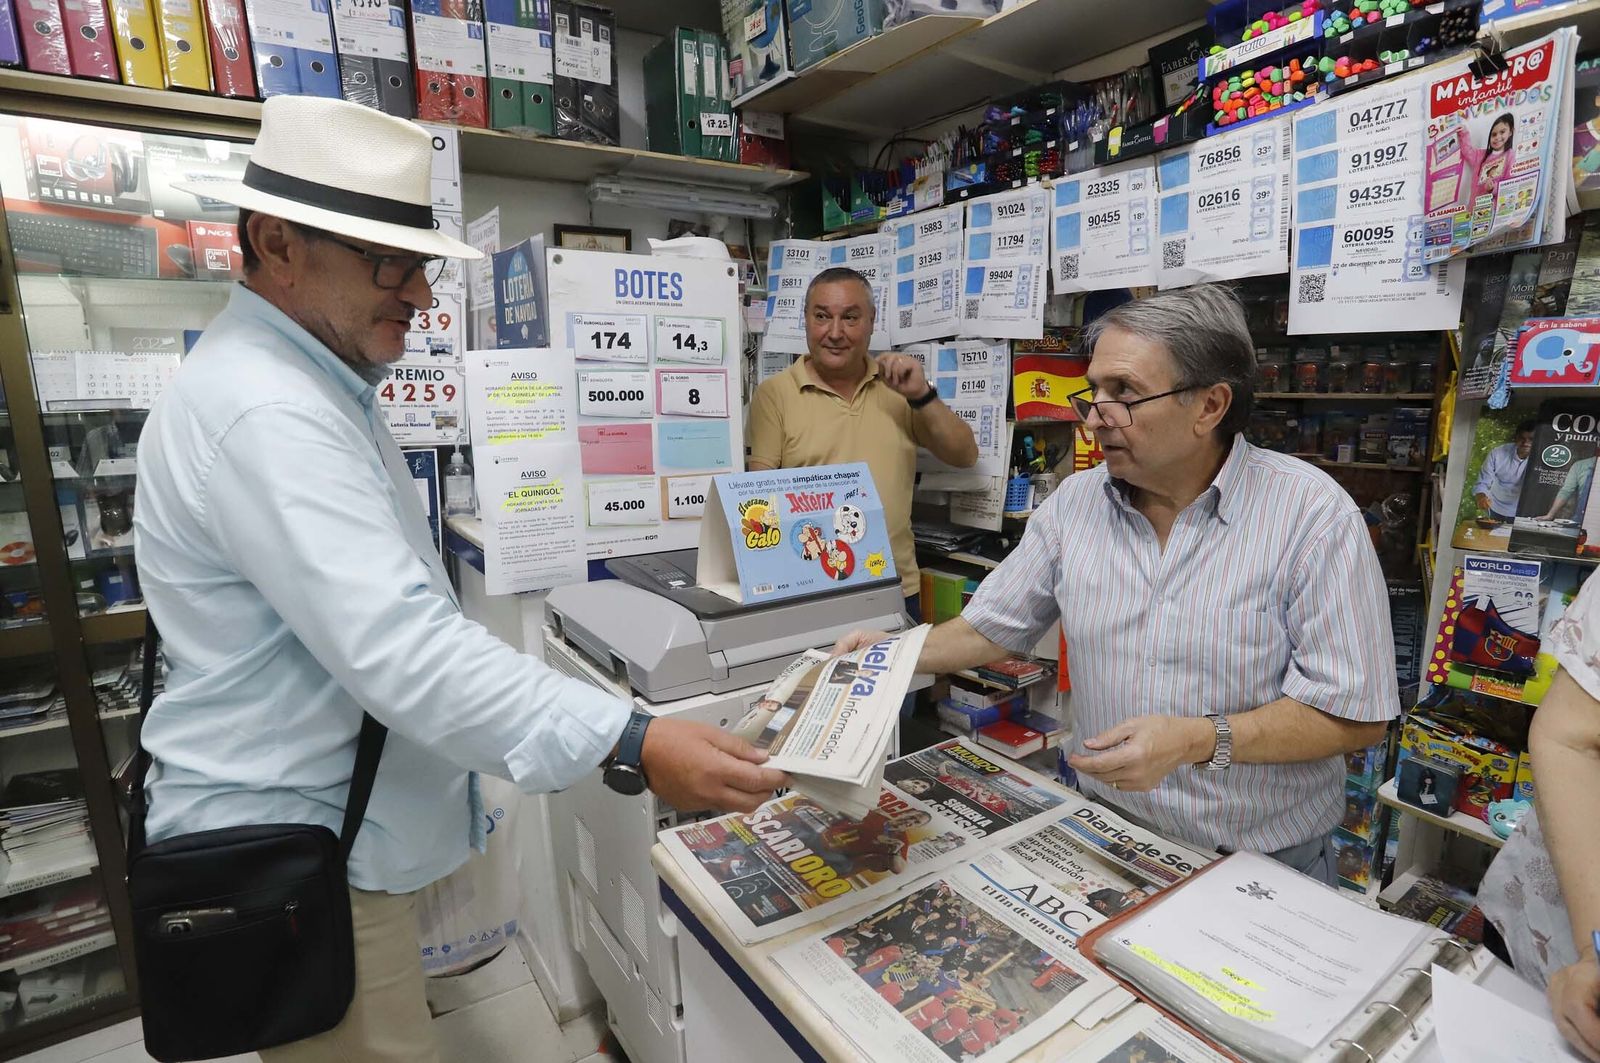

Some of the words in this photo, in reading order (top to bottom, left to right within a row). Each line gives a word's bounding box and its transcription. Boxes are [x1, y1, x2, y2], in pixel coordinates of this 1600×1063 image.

[1458, 77, 1512, 106] infantil
[1349, 98, 1408, 127] 04777
[1375, 114, 1409, 126] NACIONAL
[1198, 145, 1241, 168] 76856
[1217, 158, 1242, 167] NACIONAL
[1351, 141, 1408, 169] 91997
[1376, 156, 1409, 168] NACIONAL
[1087, 179, 1120, 196] 23335
[1349, 180, 1406, 203] 94357
[1198, 188, 1241, 209] 02616
[1217, 201, 1241, 210] NACIONAL
[1373, 196, 1406, 206] NACIONAL
[997, 202, 1026, 217] 91024
[1088, 209, 1121, 227] 90455
[1436, 205, 1465, 217] ASAMBLEA
[919, 220, 943, 235] 15883
[1344, 225, 1394, 243] 60095
[997, 234, 1024, 247] 11794
[786, 249, 810, 258] 33101
[851, 246, 875, 257] 28212
[918, 252, 942, 266] 31343
[781, 278, 802, 287] 85811
[989, 270, 1013, 280] 99404
[614, 268, 683, 301] BOTES
[918, 278, 938, 290] 30883
[504, 306, 514, 325] DE
[514, 300, 537, 324] NAVIDAD
[590, 332, 632, 350] 174
[672, 332, 708, 353] 14,3
[961, 350, 988, 362] 75710
[386, 368, 445, 382] REMIO
[510, 372, 538, 380] AVISO
[961, 380, 986, 391] 61140
[588, 390, 645, 402] 500.000
[688, 388, 700, 405] 8
[1552, 413, 1600, 434] CO
[1554, 432, 1563, 442] y
[1550, 447, 1566, 458] 2ª
[520, 469, 547, 479] AVISO
[755, 479, 776, 489] gratis
[604, 499, 645, 512] 45.000
[785, 492, 836, 514] Astérix
[746, 528, 781, 549] Galo
[1468, 560, 1512, 571] WORLD
[817, 697, 862, 761] Información
[950, 745, 1001, 773] MUNDO
[1043, 828, 1085, 854] Juanma
[1073, 808, 1131, 844] Diario
[1136, 841, 1161, 858] de
[1036, 831, 1073, 858] Moreno
[1009, 845, 1038, 863] fiscal
[1017, 840, 1032, 850] su
[1029, 846, 1085, 882] revolución
[1026, 836, 1069, 863] aprueba
[1065, 858, 1087, 874] hoy
[981, 884, 997, 897] El
[995, 894, 1013, 908] fin
[1013, 906, 1029, 919] de
[1029, 916, 1055, 936] una
[1010, 883, 1093, 930] ABC
